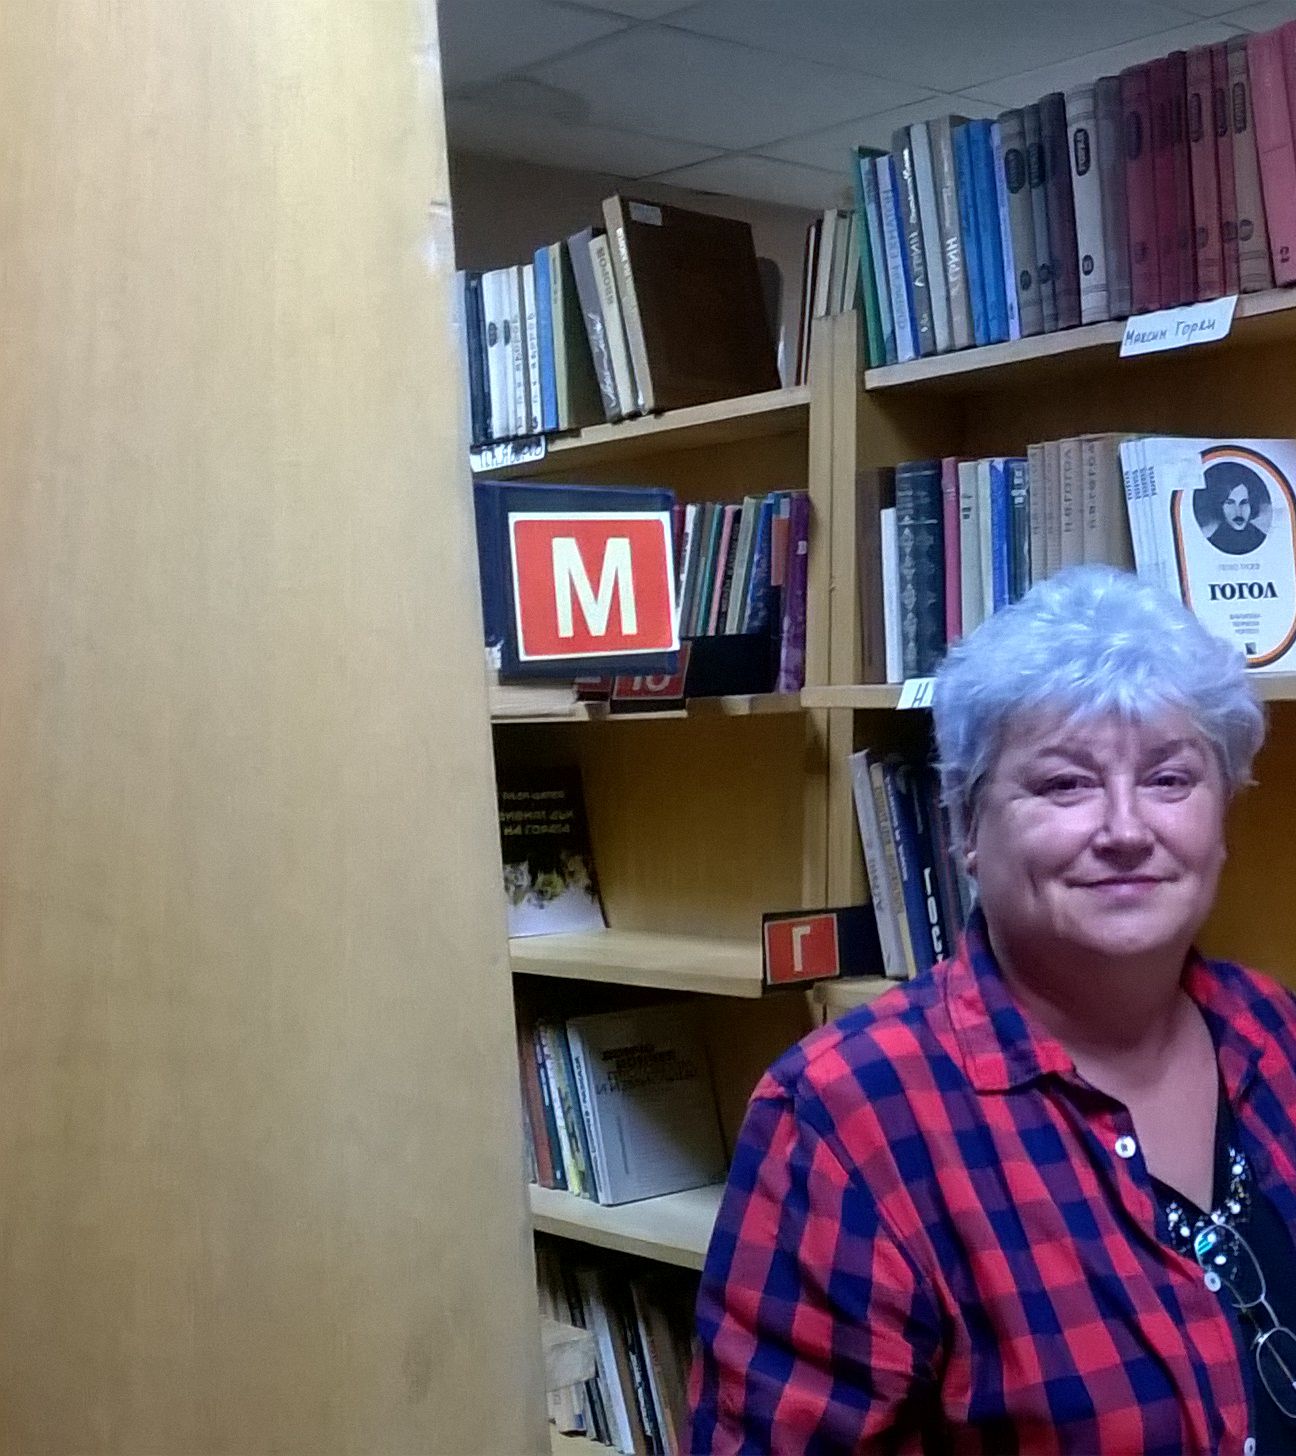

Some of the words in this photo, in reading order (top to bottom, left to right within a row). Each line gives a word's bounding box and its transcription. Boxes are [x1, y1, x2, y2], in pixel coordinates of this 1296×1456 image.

[1279, 246, 1290, 263] 2
[1125, 328, 1168, 347] Максим
[551, 537, 638, 639] М
[1208, 581, 1278, 601] ГОГОЛ
[791, 924, 811, 973] Г
